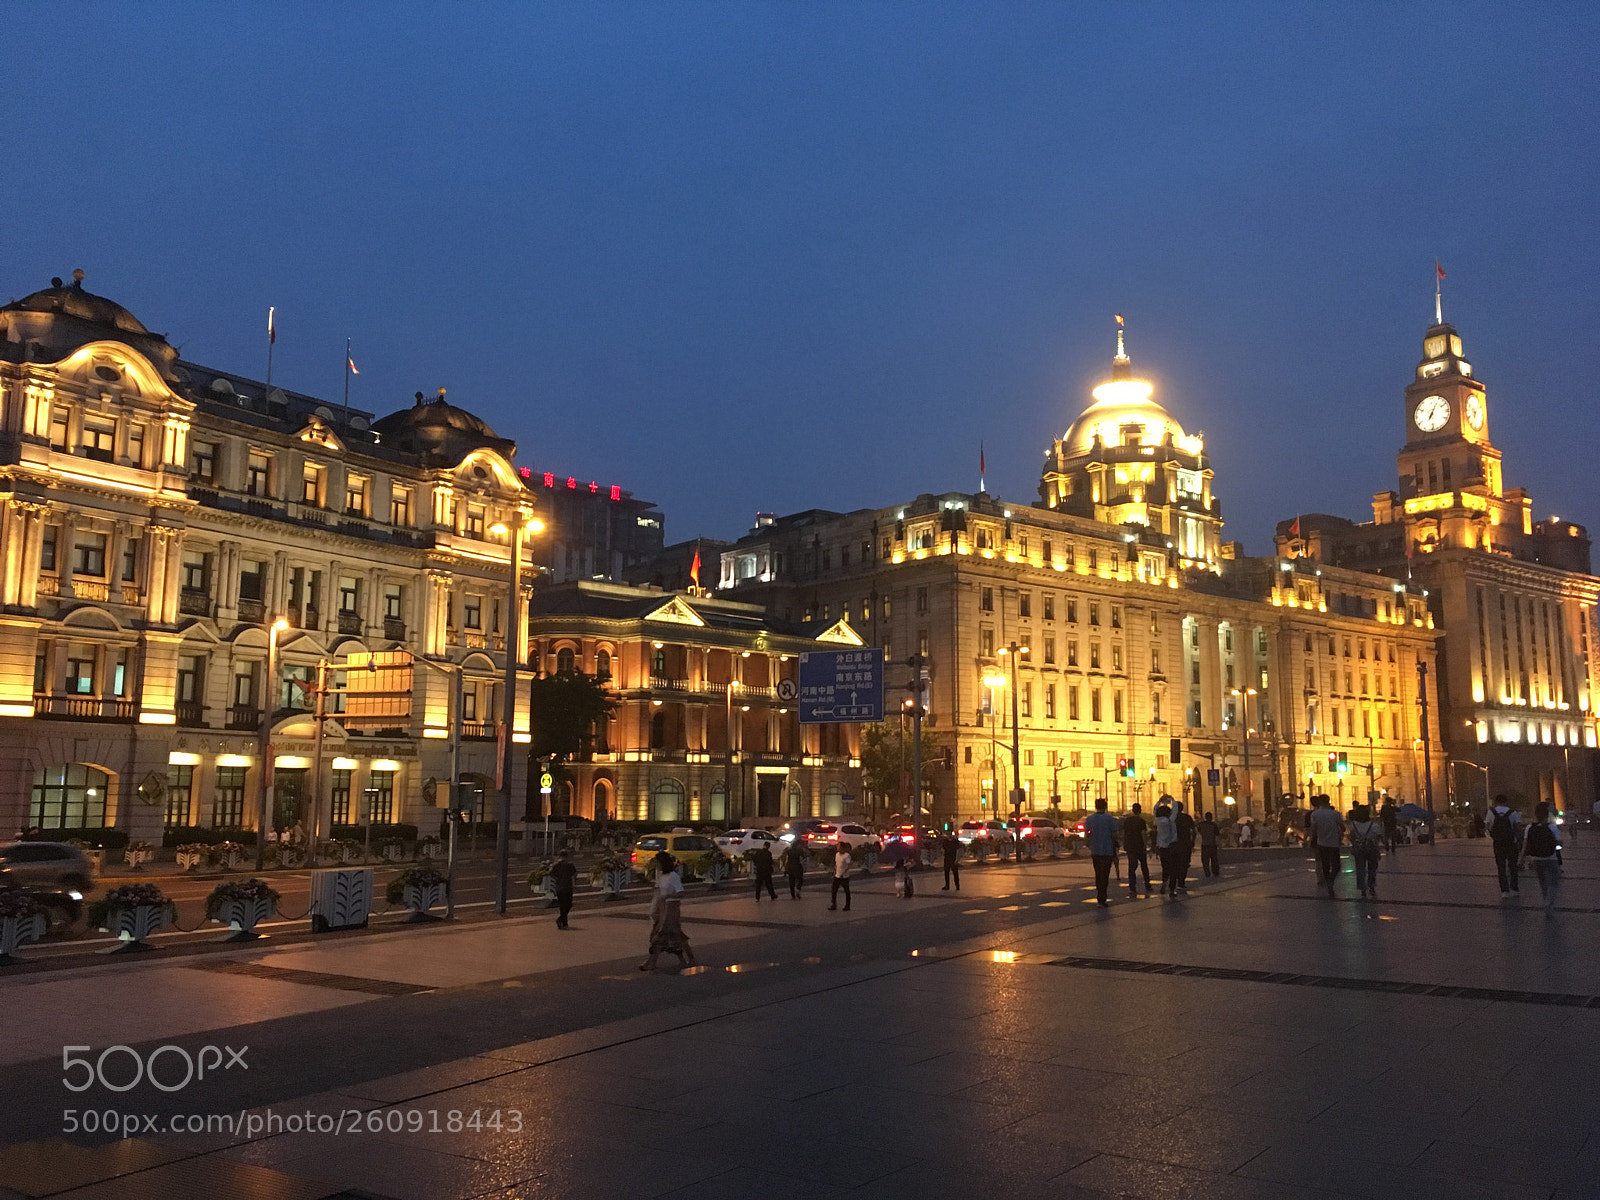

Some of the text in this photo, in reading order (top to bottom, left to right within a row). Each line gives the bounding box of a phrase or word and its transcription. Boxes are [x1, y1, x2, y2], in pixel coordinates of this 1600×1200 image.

[836, 652, 872, 663] 外白渡桥
[836, 672, 872, 682] 南京东路
[801, 685, 834, 696] 河南中路
